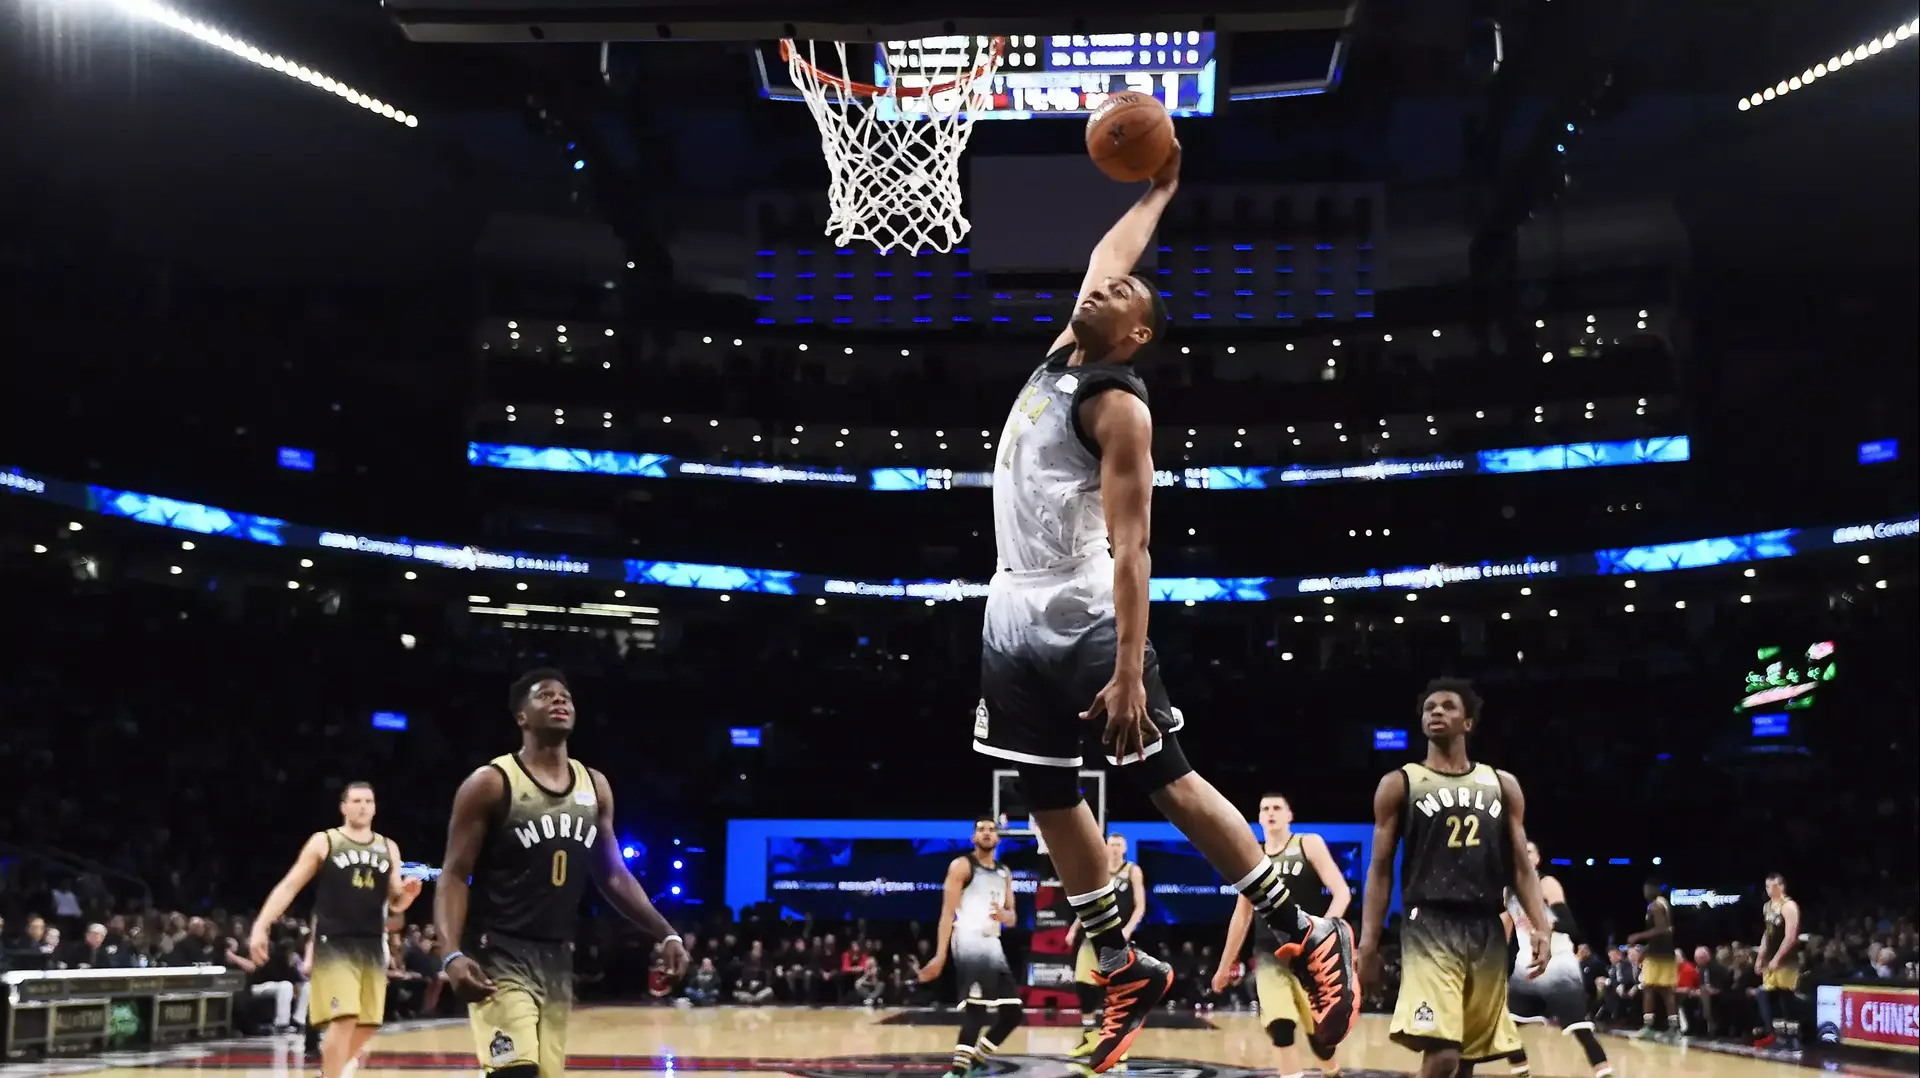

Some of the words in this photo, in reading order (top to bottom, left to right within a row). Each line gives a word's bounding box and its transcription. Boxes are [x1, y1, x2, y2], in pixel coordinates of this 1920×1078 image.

[1482, 561, 1557, 577] CHALLENGE
[1415, 786, 1502, 819] WORLD
[514, 812, 598, 849] WORLD
[1446, 814, 1480, 848] 22
[332, 849, 390, 874] WORLD
[552, 849, 568, 887] 0
[1273, 860, 1304, 877] RLD
